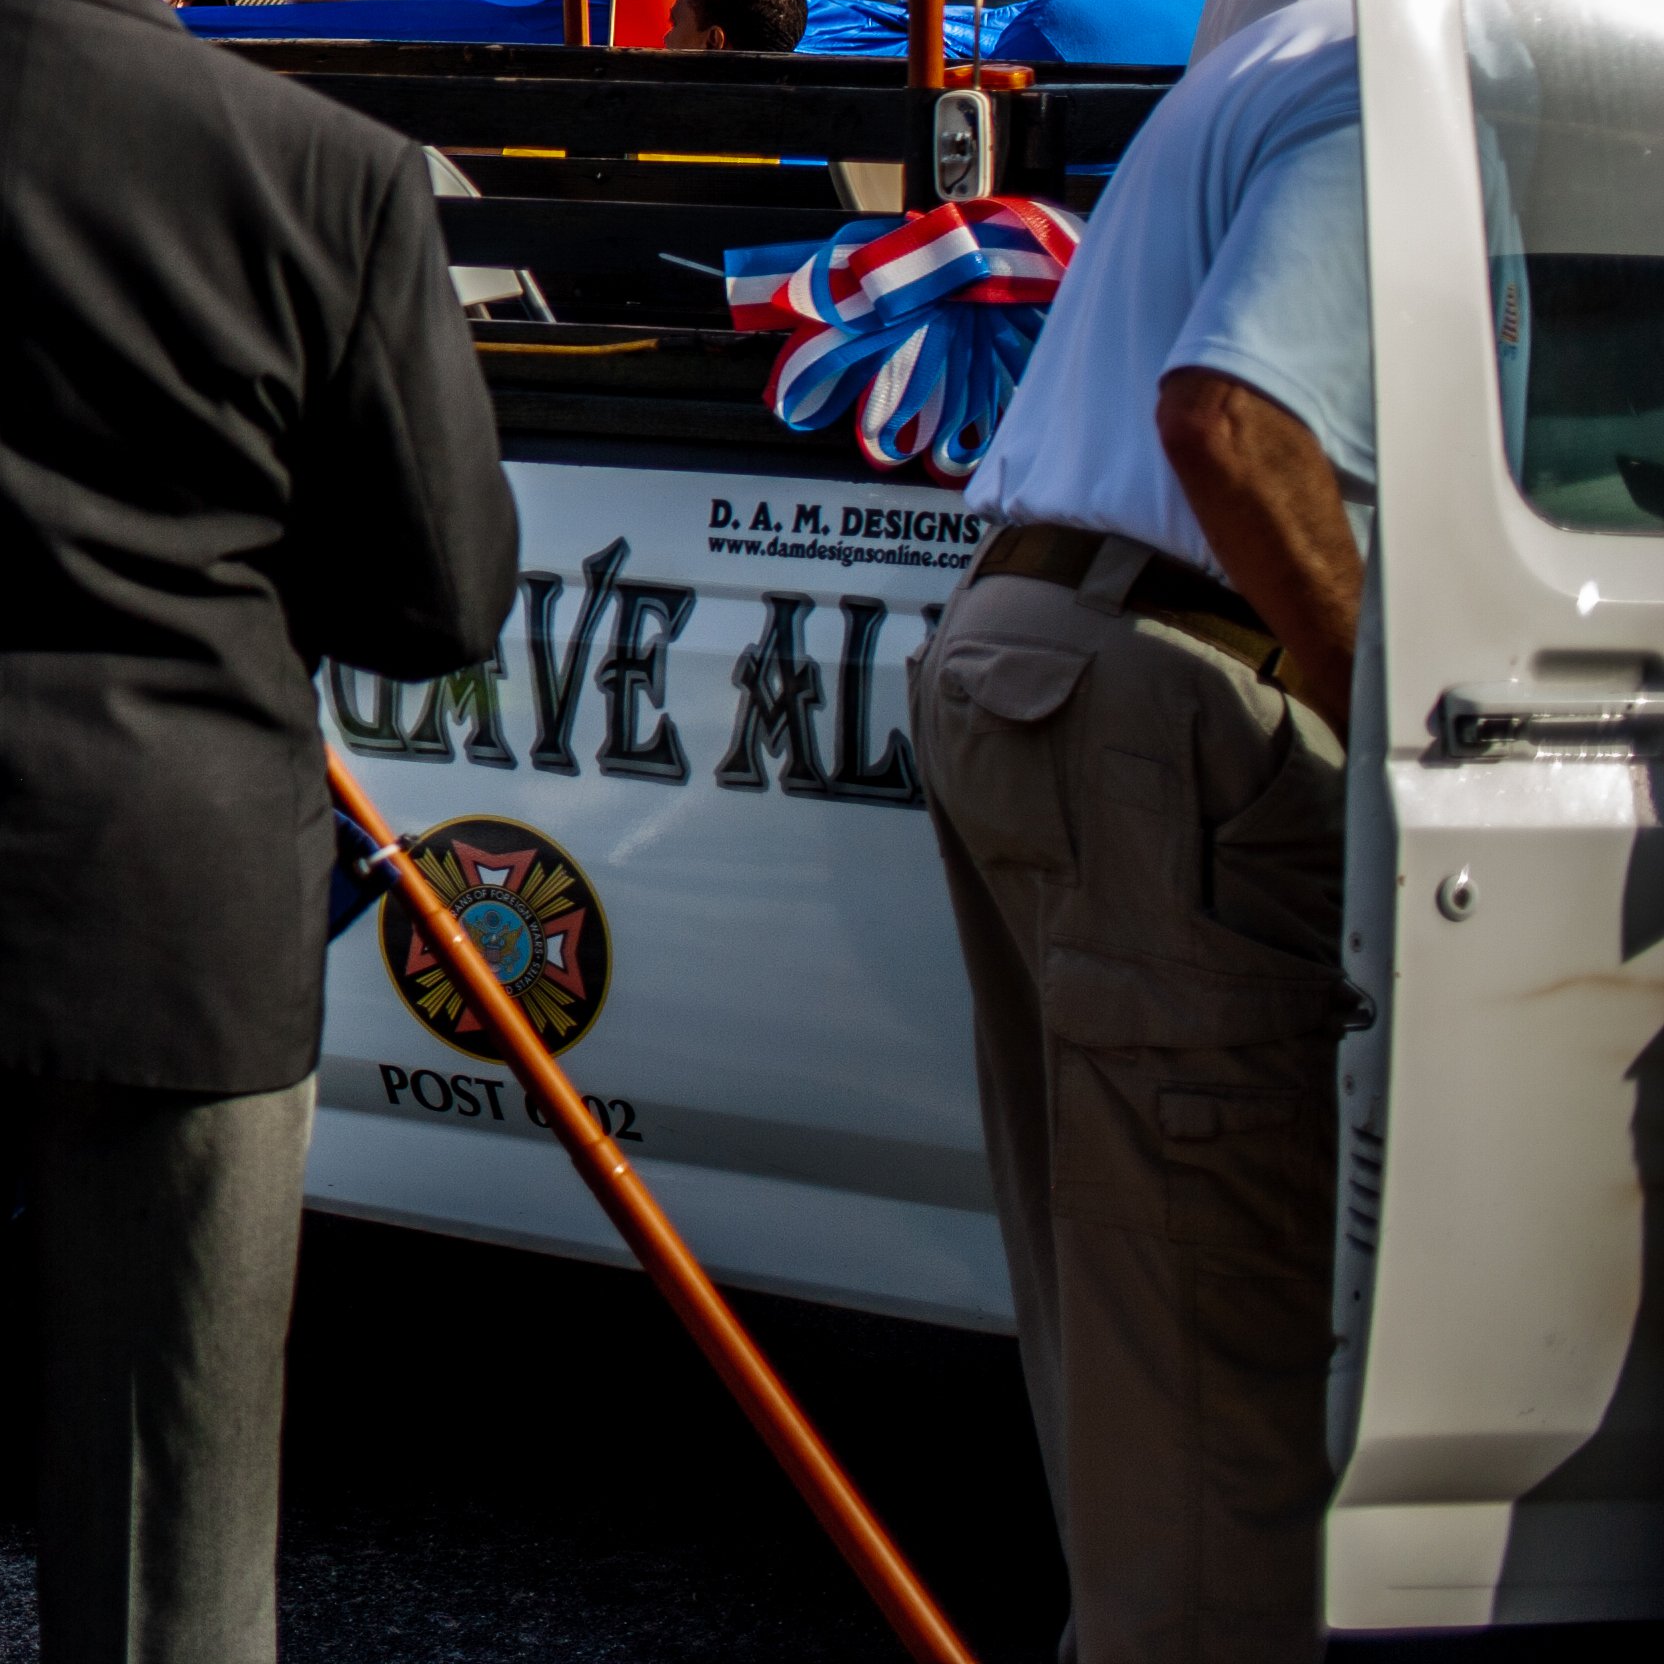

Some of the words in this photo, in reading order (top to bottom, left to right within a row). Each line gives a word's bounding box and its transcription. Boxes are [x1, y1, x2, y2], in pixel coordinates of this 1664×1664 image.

[709, 499, 740, 530] D.
[749, 502, 782, 532] A.
[792, 504, 830, 536] M.
[839, 506, 981, 545] DESIGNS
[715, 592, 944, 805] AL
[490, 889, 532, 920] FOREIGN
[378, 1064, 505, 1121] POST
